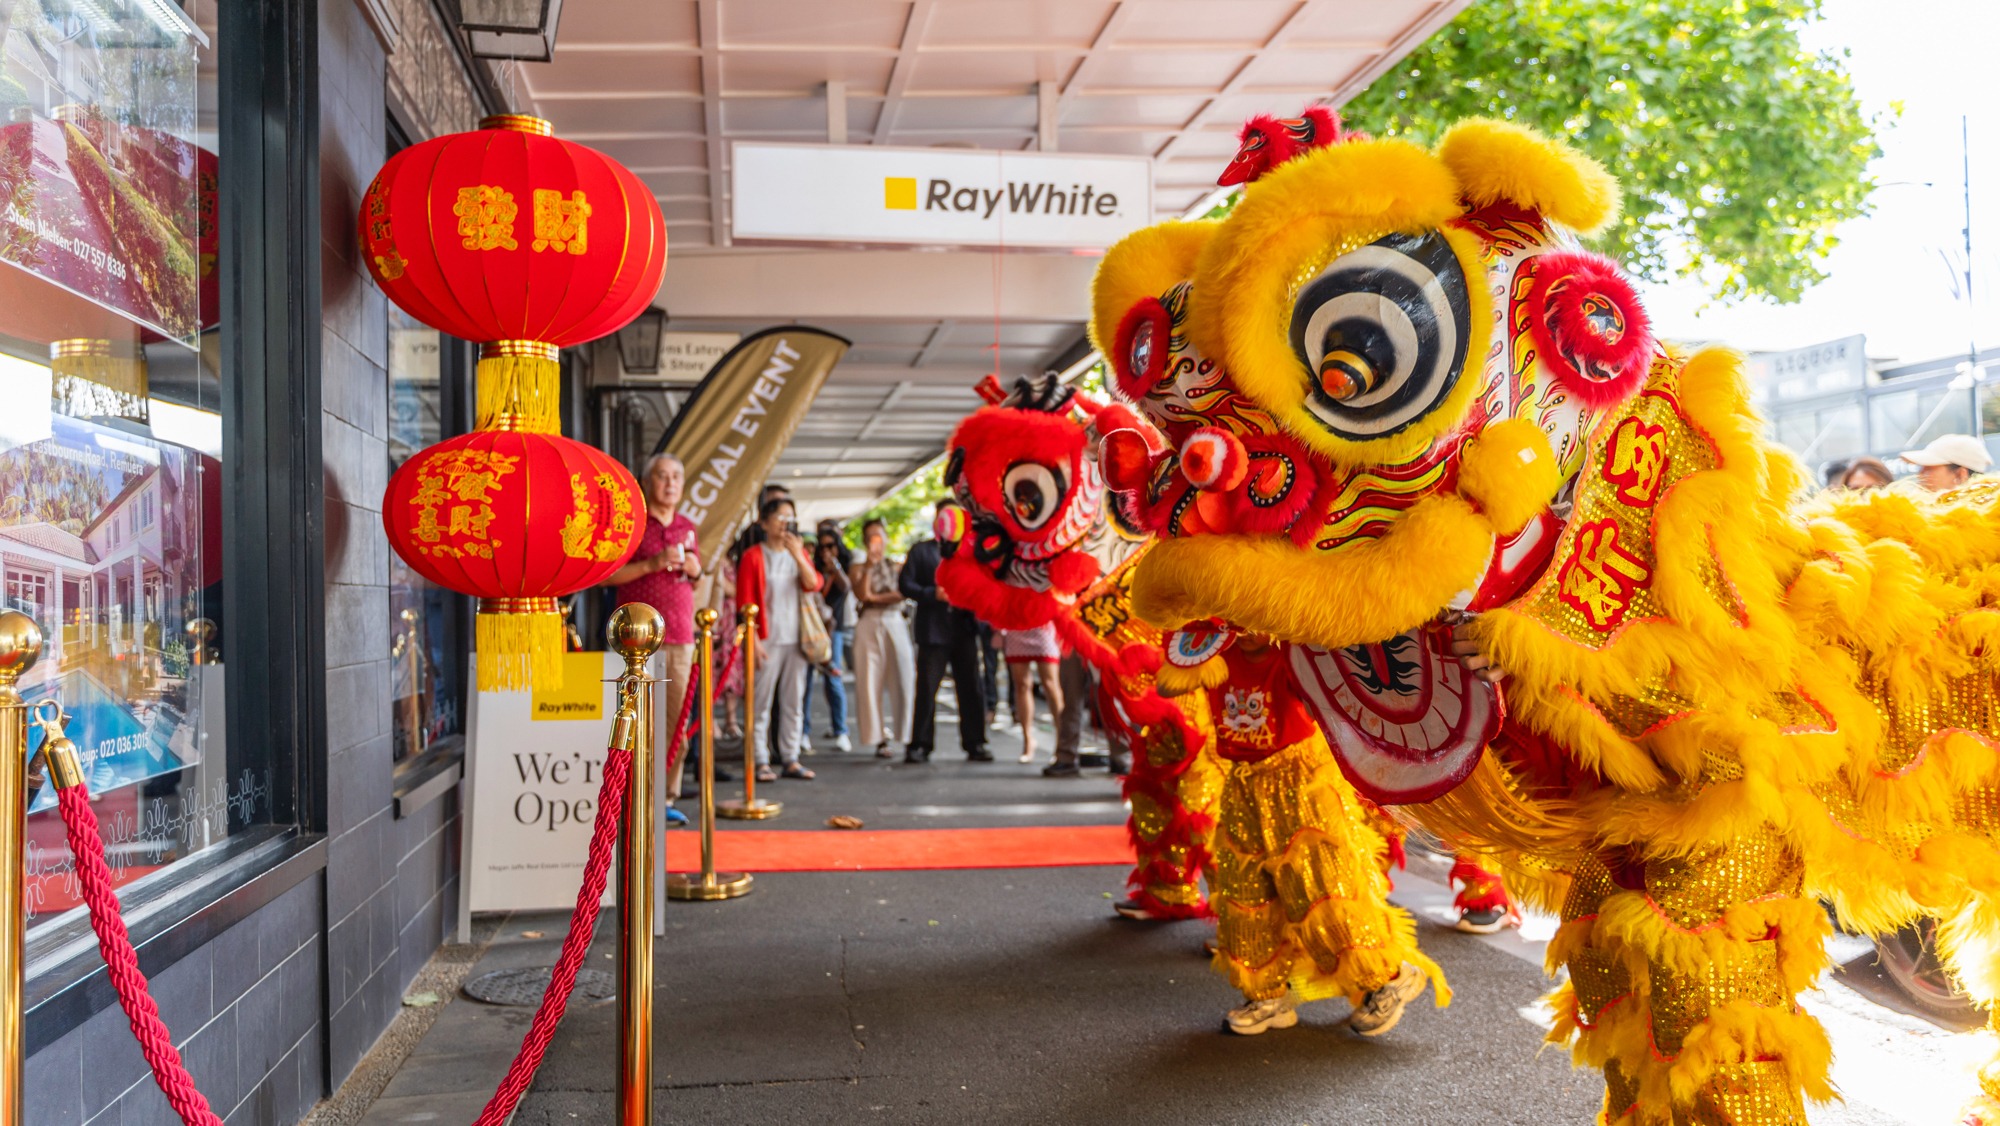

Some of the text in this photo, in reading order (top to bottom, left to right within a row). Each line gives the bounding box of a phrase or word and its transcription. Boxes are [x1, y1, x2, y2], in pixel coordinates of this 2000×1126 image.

[453, 184, 592, 255] 發財
[8, 202, 127, 280] Steen Nielsen: 027 557 8336
[678, 442, 746, 526] ECIAL
[730, 337, 802, 438] EVENT
[84, 444, 109, 471] Road,
[110, 450, 144, 476] Remuera
[538, 702, 597, 713] RayWhite
[101, 739, 115, 758] 022
[117, 735, 131, 755] 036
[132, 732, 149, 751] 3015
[513, 751, 603, 785] We’r
[513, 791, 599, 832] Ope
